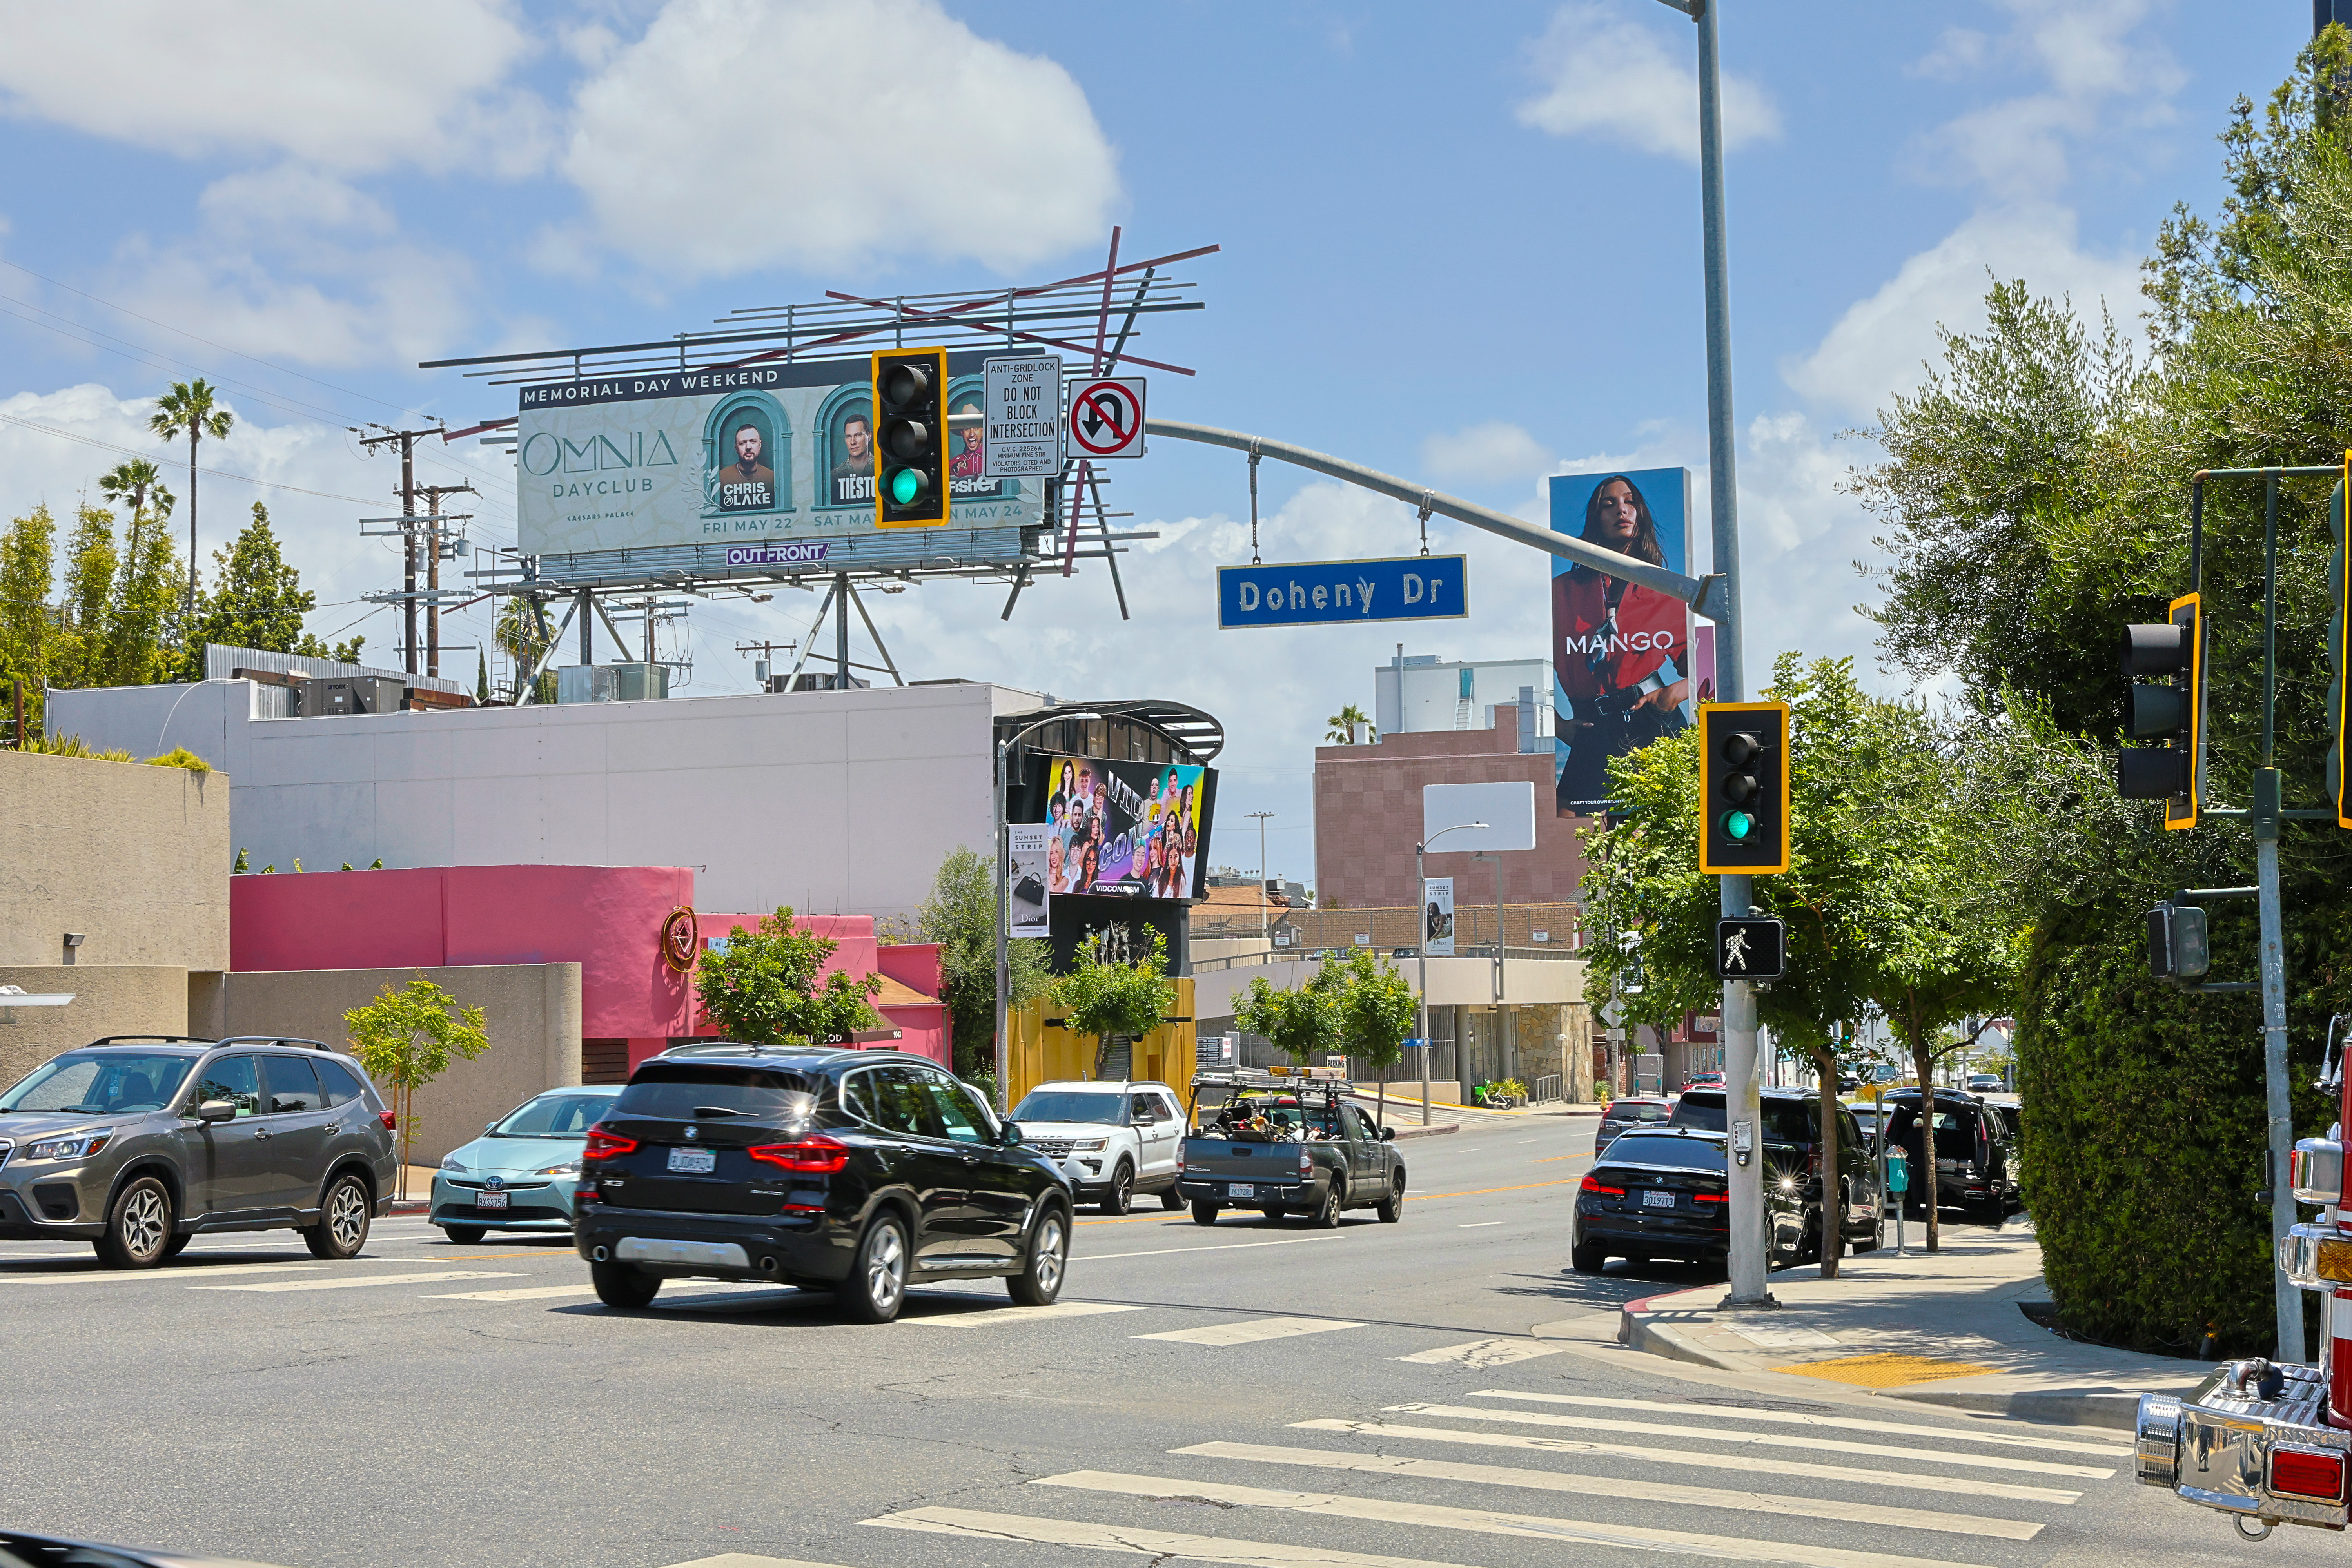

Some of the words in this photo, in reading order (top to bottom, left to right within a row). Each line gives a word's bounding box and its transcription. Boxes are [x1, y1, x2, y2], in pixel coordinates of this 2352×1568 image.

[991, 363, 1055, 374] ANTI-GRIDLOCK
[1012, 374, 1034, 383] ZONE
[524, 383, 623, 403] MEMORIAL
[635, 379, 671, 393] DAY
[681, 370, 778, 389] WEEKEND
[1004, 387, 1017, 402] DO
[1024, 386, 1041, 401] NOT
[1007, 405, 1038, 420] BLOCK
[990, 421, 1054, 439] INTERSECTION
[523, 430, 678, 475] OMNIA
[554, 478, 652, 498] DAYCLUB
[723, 482, 765, 495] CHRIS
[734, 492, 771, 506] LAKE
[965, 506, 998, 518] MAY
[1004, 505, 1022, 516] 24
[703, 522, 726, 534] FRI
[735, 519, 768, 532] MAY
[775, 518, 792, 529] 22
[814, 515, 842, 527] SAT
[849, 513, 876, 525] MA
[1240, 580, 1375, 613] Doheny
[1403, 573, 1443, 605] Dr
[1566, 630, 1673, 654] MANGO
[1107, 769, 1144, 822] VID
[1098, 822, 1143, 872] CON
[1020, 914, 1039, 922] Dior
[1328, 1059, 1345, 1068] PARKING
[479, 1198, 506, 1207] 8XSS756
[1644, 1196, 1673, 1206] 30197T3
